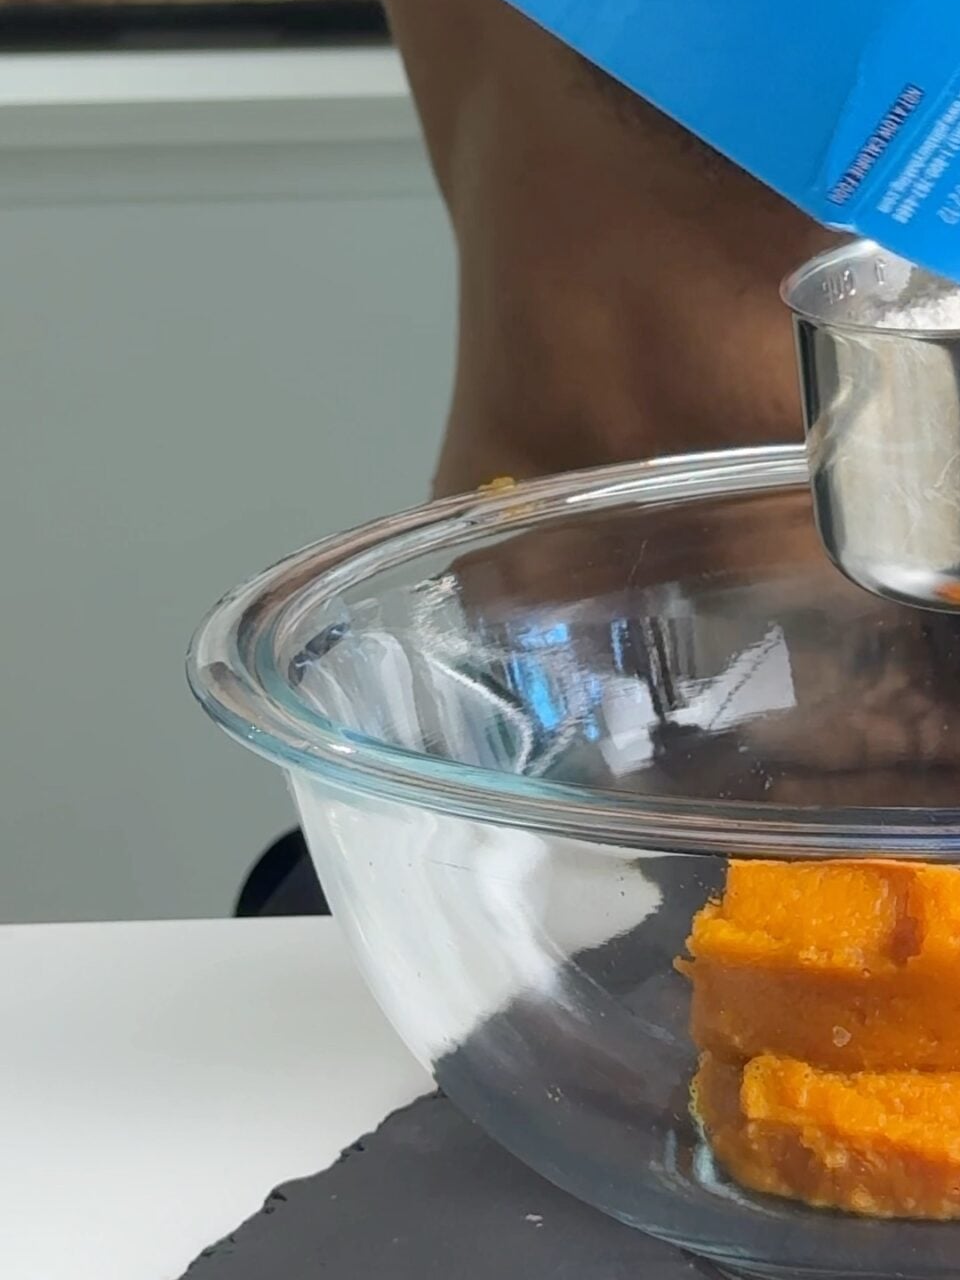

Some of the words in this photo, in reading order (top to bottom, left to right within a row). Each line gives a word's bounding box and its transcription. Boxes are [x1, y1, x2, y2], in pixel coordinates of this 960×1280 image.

[897, 85, 921, 110] NOT
[890, 104, 907, 118] A
[875, 112, 902, 140] LOW
[846, 134, 887, 179] CALORIE
